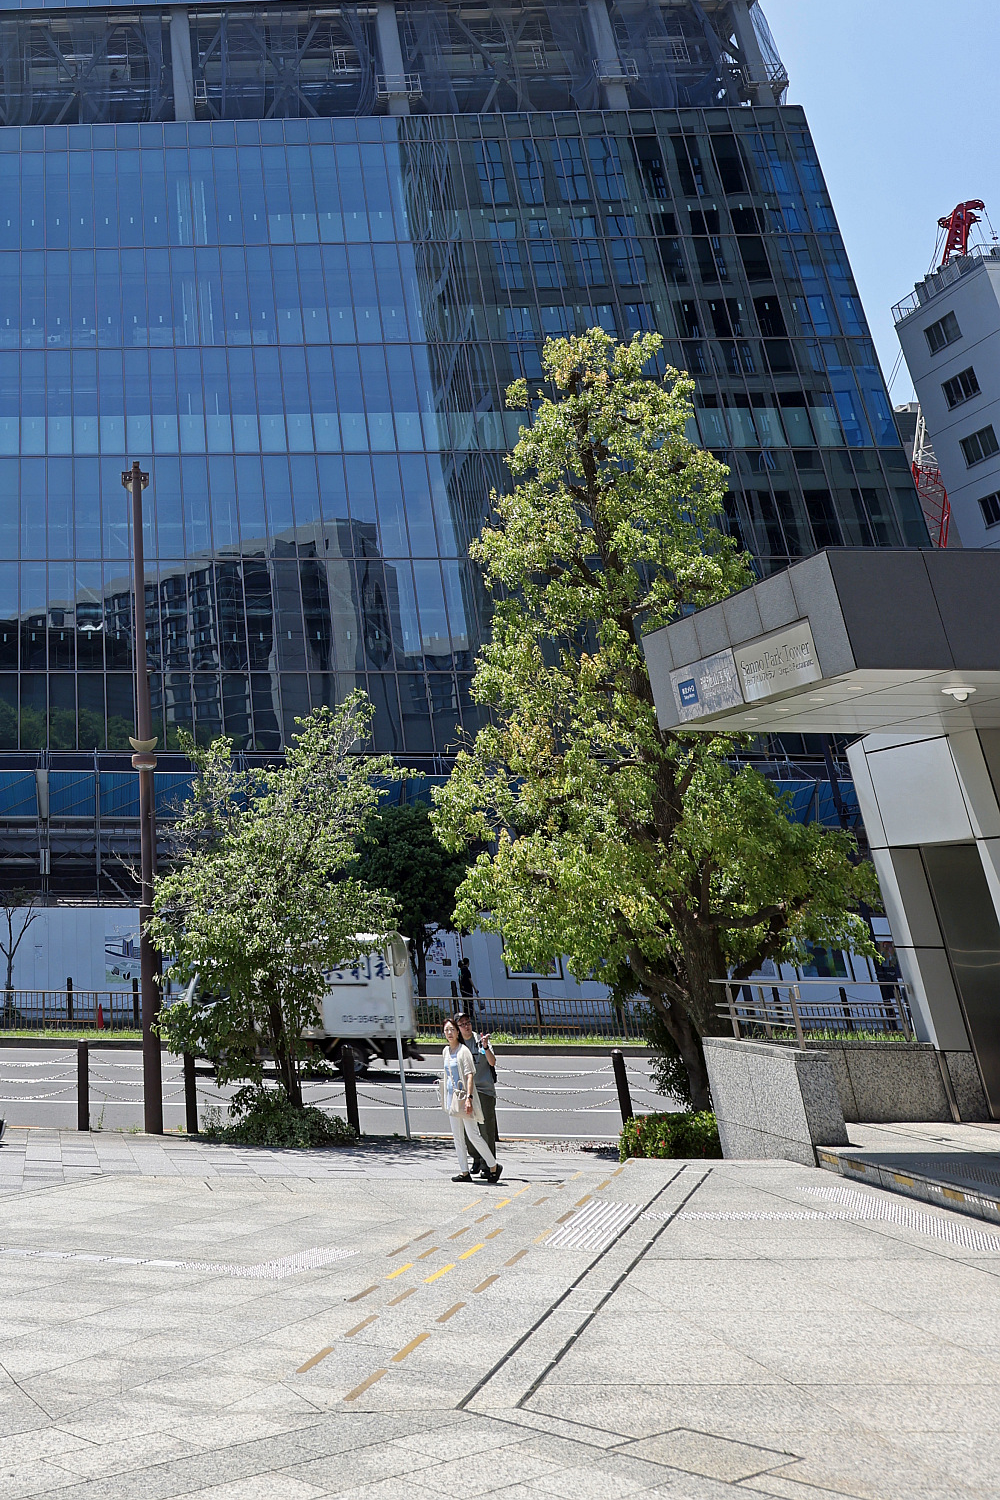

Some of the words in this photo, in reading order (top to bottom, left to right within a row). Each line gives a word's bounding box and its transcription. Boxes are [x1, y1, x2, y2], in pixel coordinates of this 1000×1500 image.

[741, 659, 765, 676] Sanno
[763, 647, 784, 668] Park
[782, 641, 810, 662] Tower
